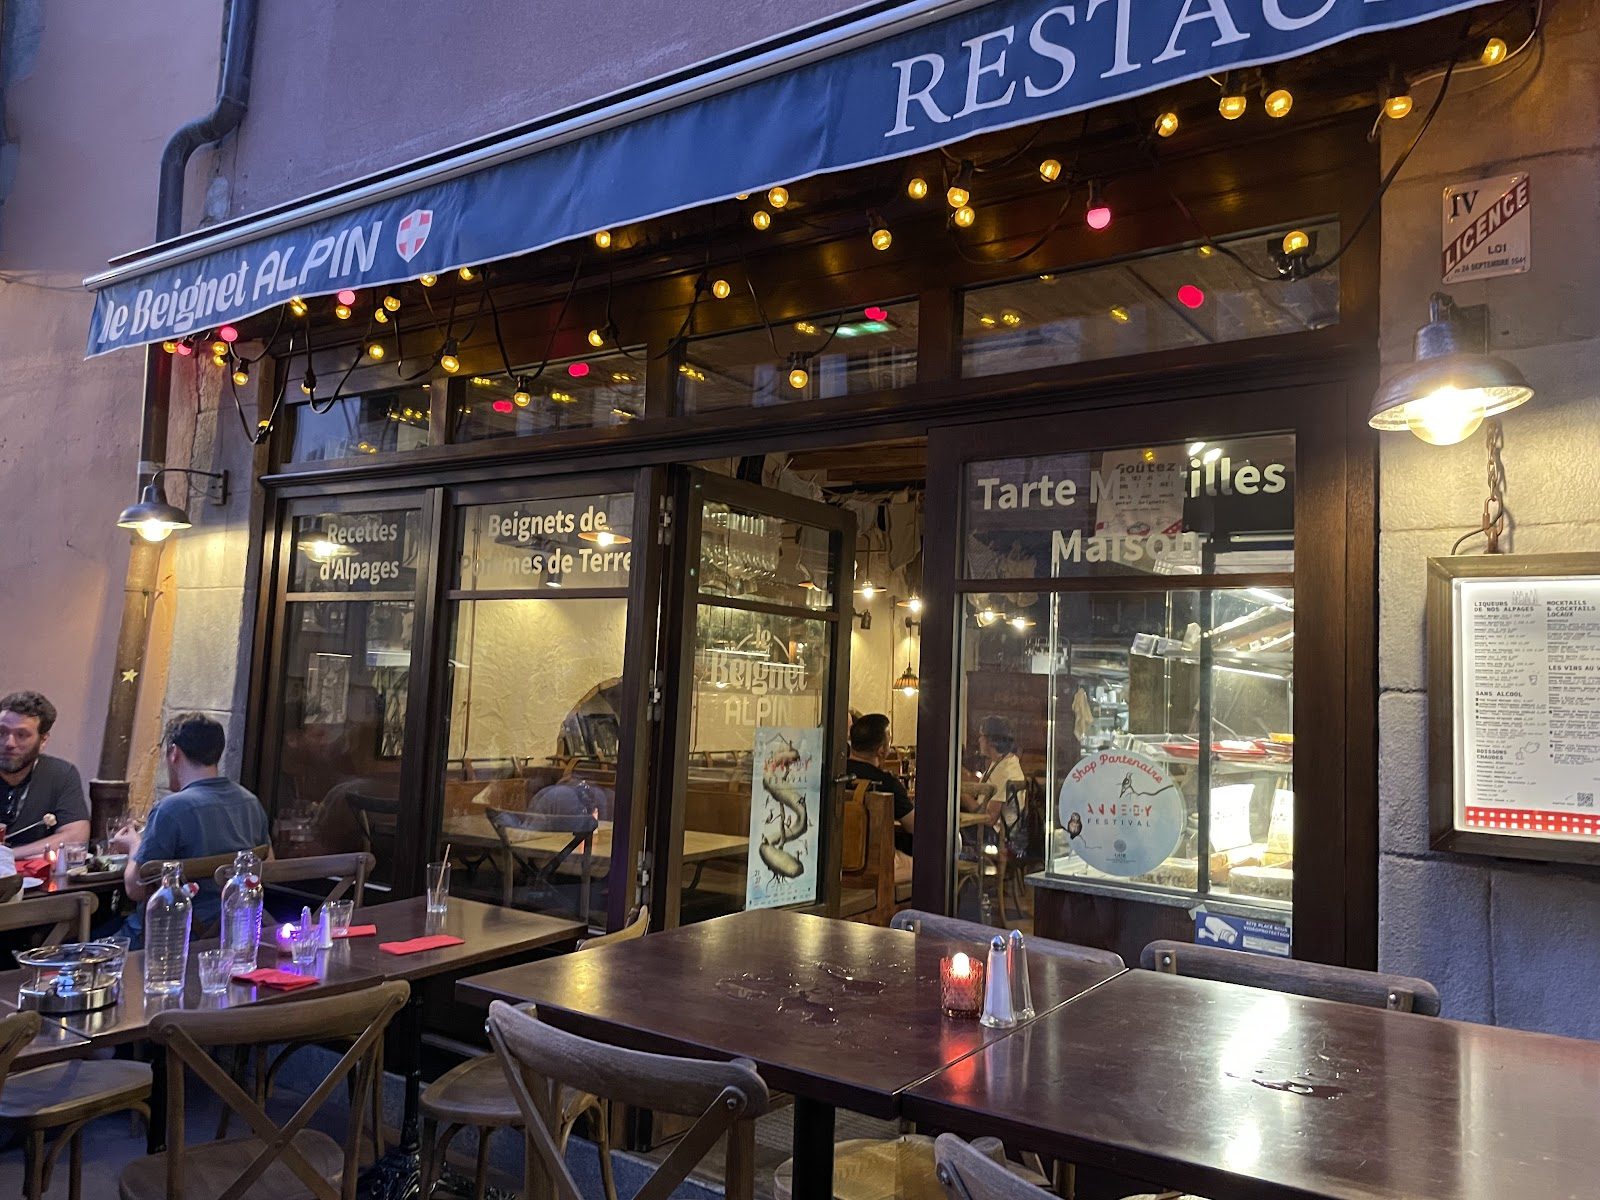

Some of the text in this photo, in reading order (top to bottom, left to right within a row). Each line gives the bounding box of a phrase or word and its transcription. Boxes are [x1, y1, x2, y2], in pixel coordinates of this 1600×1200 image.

[884, 0, 1385, 138] RESTA
[1451, 189, 1479, 218] IV
[1445, 180, 1527, 274] LICENCE
[1471, 258, 1509, 271] SEPTEMBRE
[1488, 243, 1507, 255] LOI
[98, 220, 383, 344] le Beignet ALPIN
[977, 457, 1287, 511] Tarte Milles
[327, 520, 398, 544] Recettes
[488, 505, 607, 542] Beignets de
[1051, 529, 1200, 564] Maison
[320, 556, 400, 585] d'Alpages
[461, 548, 631, 577] Pomes de Terre
[711, 650, 808, 695] Beignet
[725, 695, 793, 727] ALPIN
[1072, 753, 1163, 783] Shop Partenaire
[1087, 818, 1151, 828] FESTIVAL
